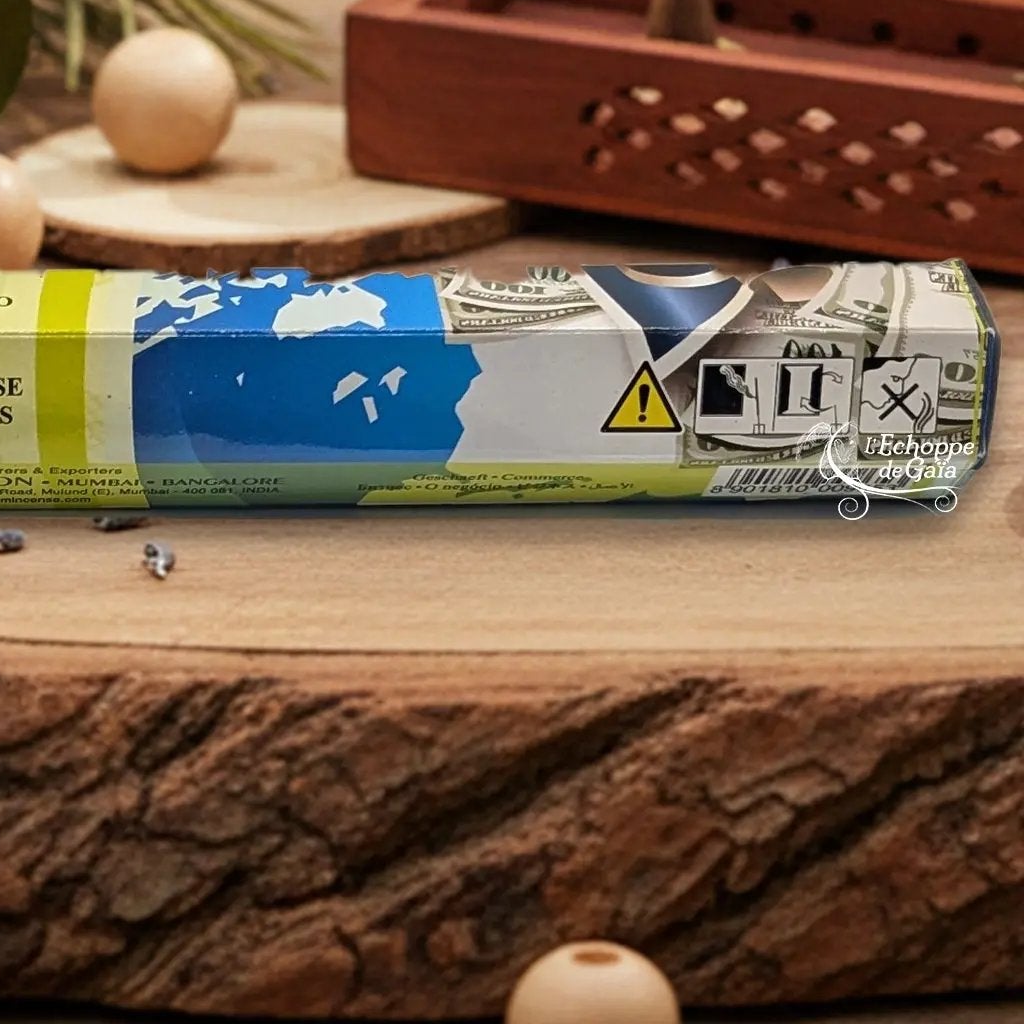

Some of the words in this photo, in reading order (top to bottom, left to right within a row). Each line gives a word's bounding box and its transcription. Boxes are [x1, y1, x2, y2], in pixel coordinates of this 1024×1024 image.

[32, 466, 44, 475] &
[49, 466, 123, 475] Exporters
[57, 478, 140, 487] MUMBAI
[162, 477, 287, 486] BANGALORE
[42, 488, 88, 496] Mulund
[119, 487, 170, 495] Mumbai
[710, 484, 724, 494] 8
[729, 484, 809, 494] 901810
